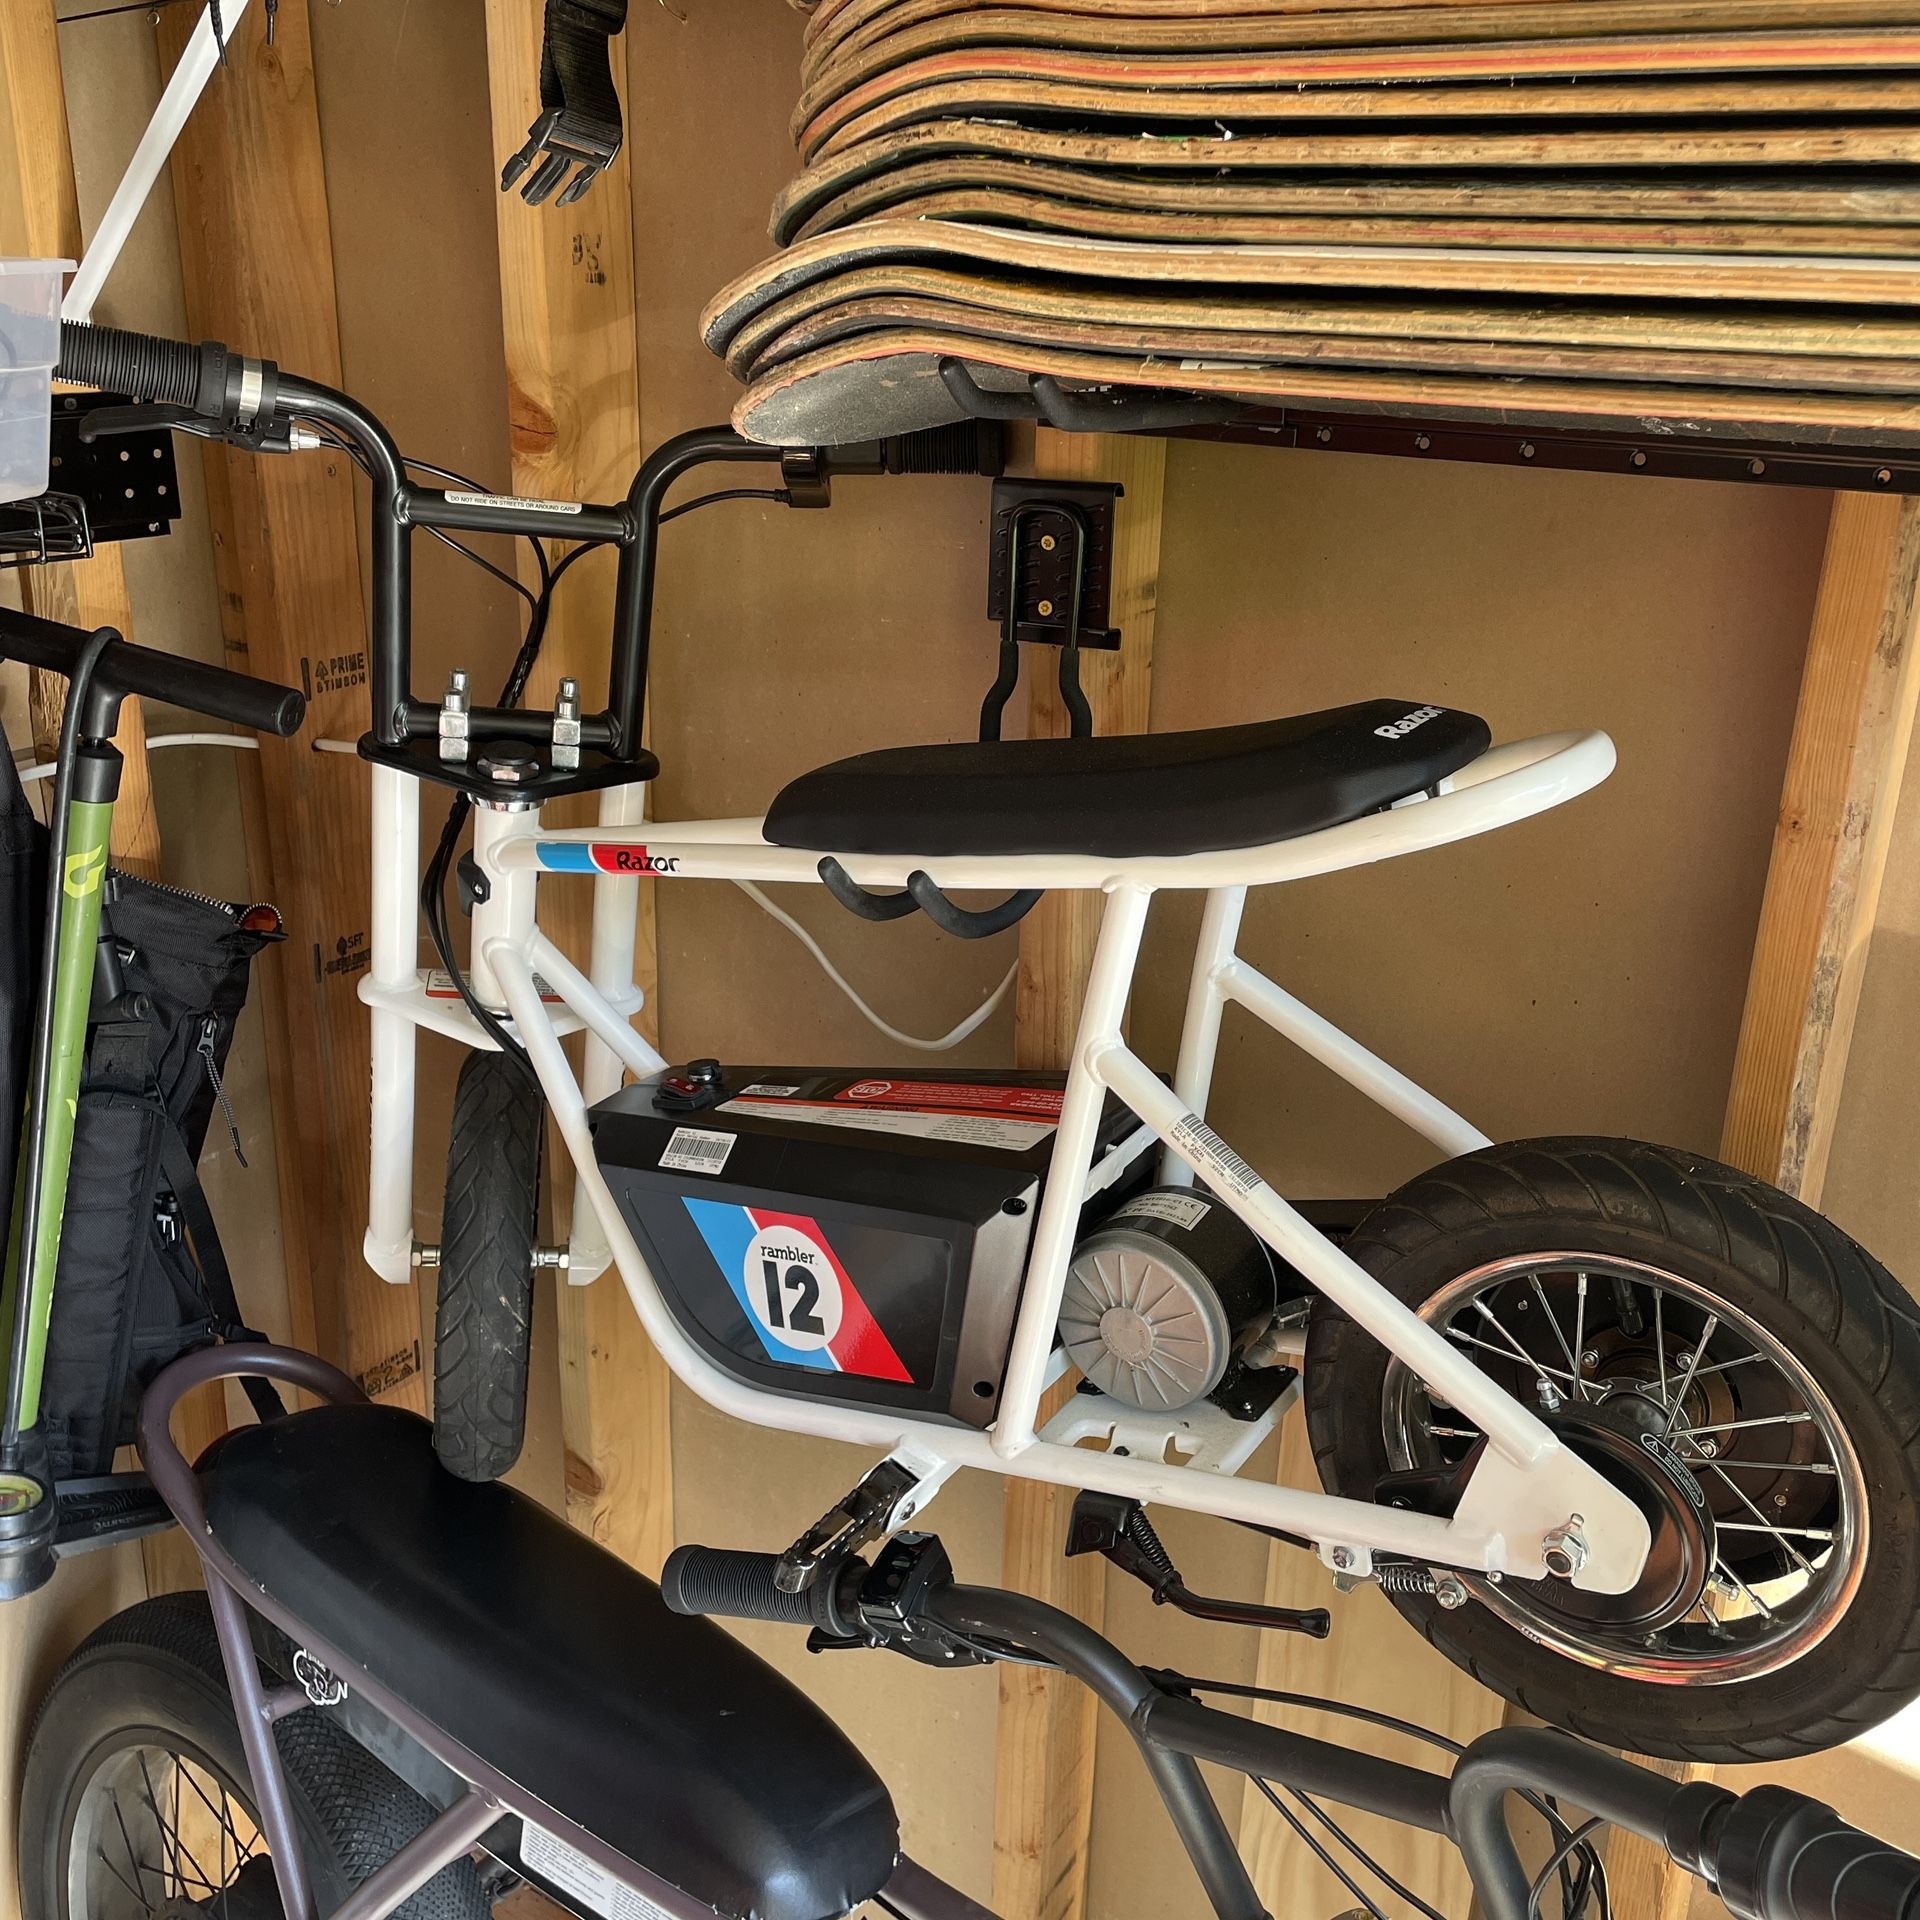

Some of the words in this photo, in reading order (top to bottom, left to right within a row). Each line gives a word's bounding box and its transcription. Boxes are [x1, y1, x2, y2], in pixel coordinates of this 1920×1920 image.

[499, 500, 525, 508] STREETS
[535, 503, 559, 511] AROUND
[560, 505, 576, 513] CARS
[330, 652, 365, 676] PRIME
[1373, 706, 1445, 739] Razor
[616, 850, 681, 873] Razor
[760, 1245, 815, 1265] rambler
[763, 1259, 826, 1336] 12
